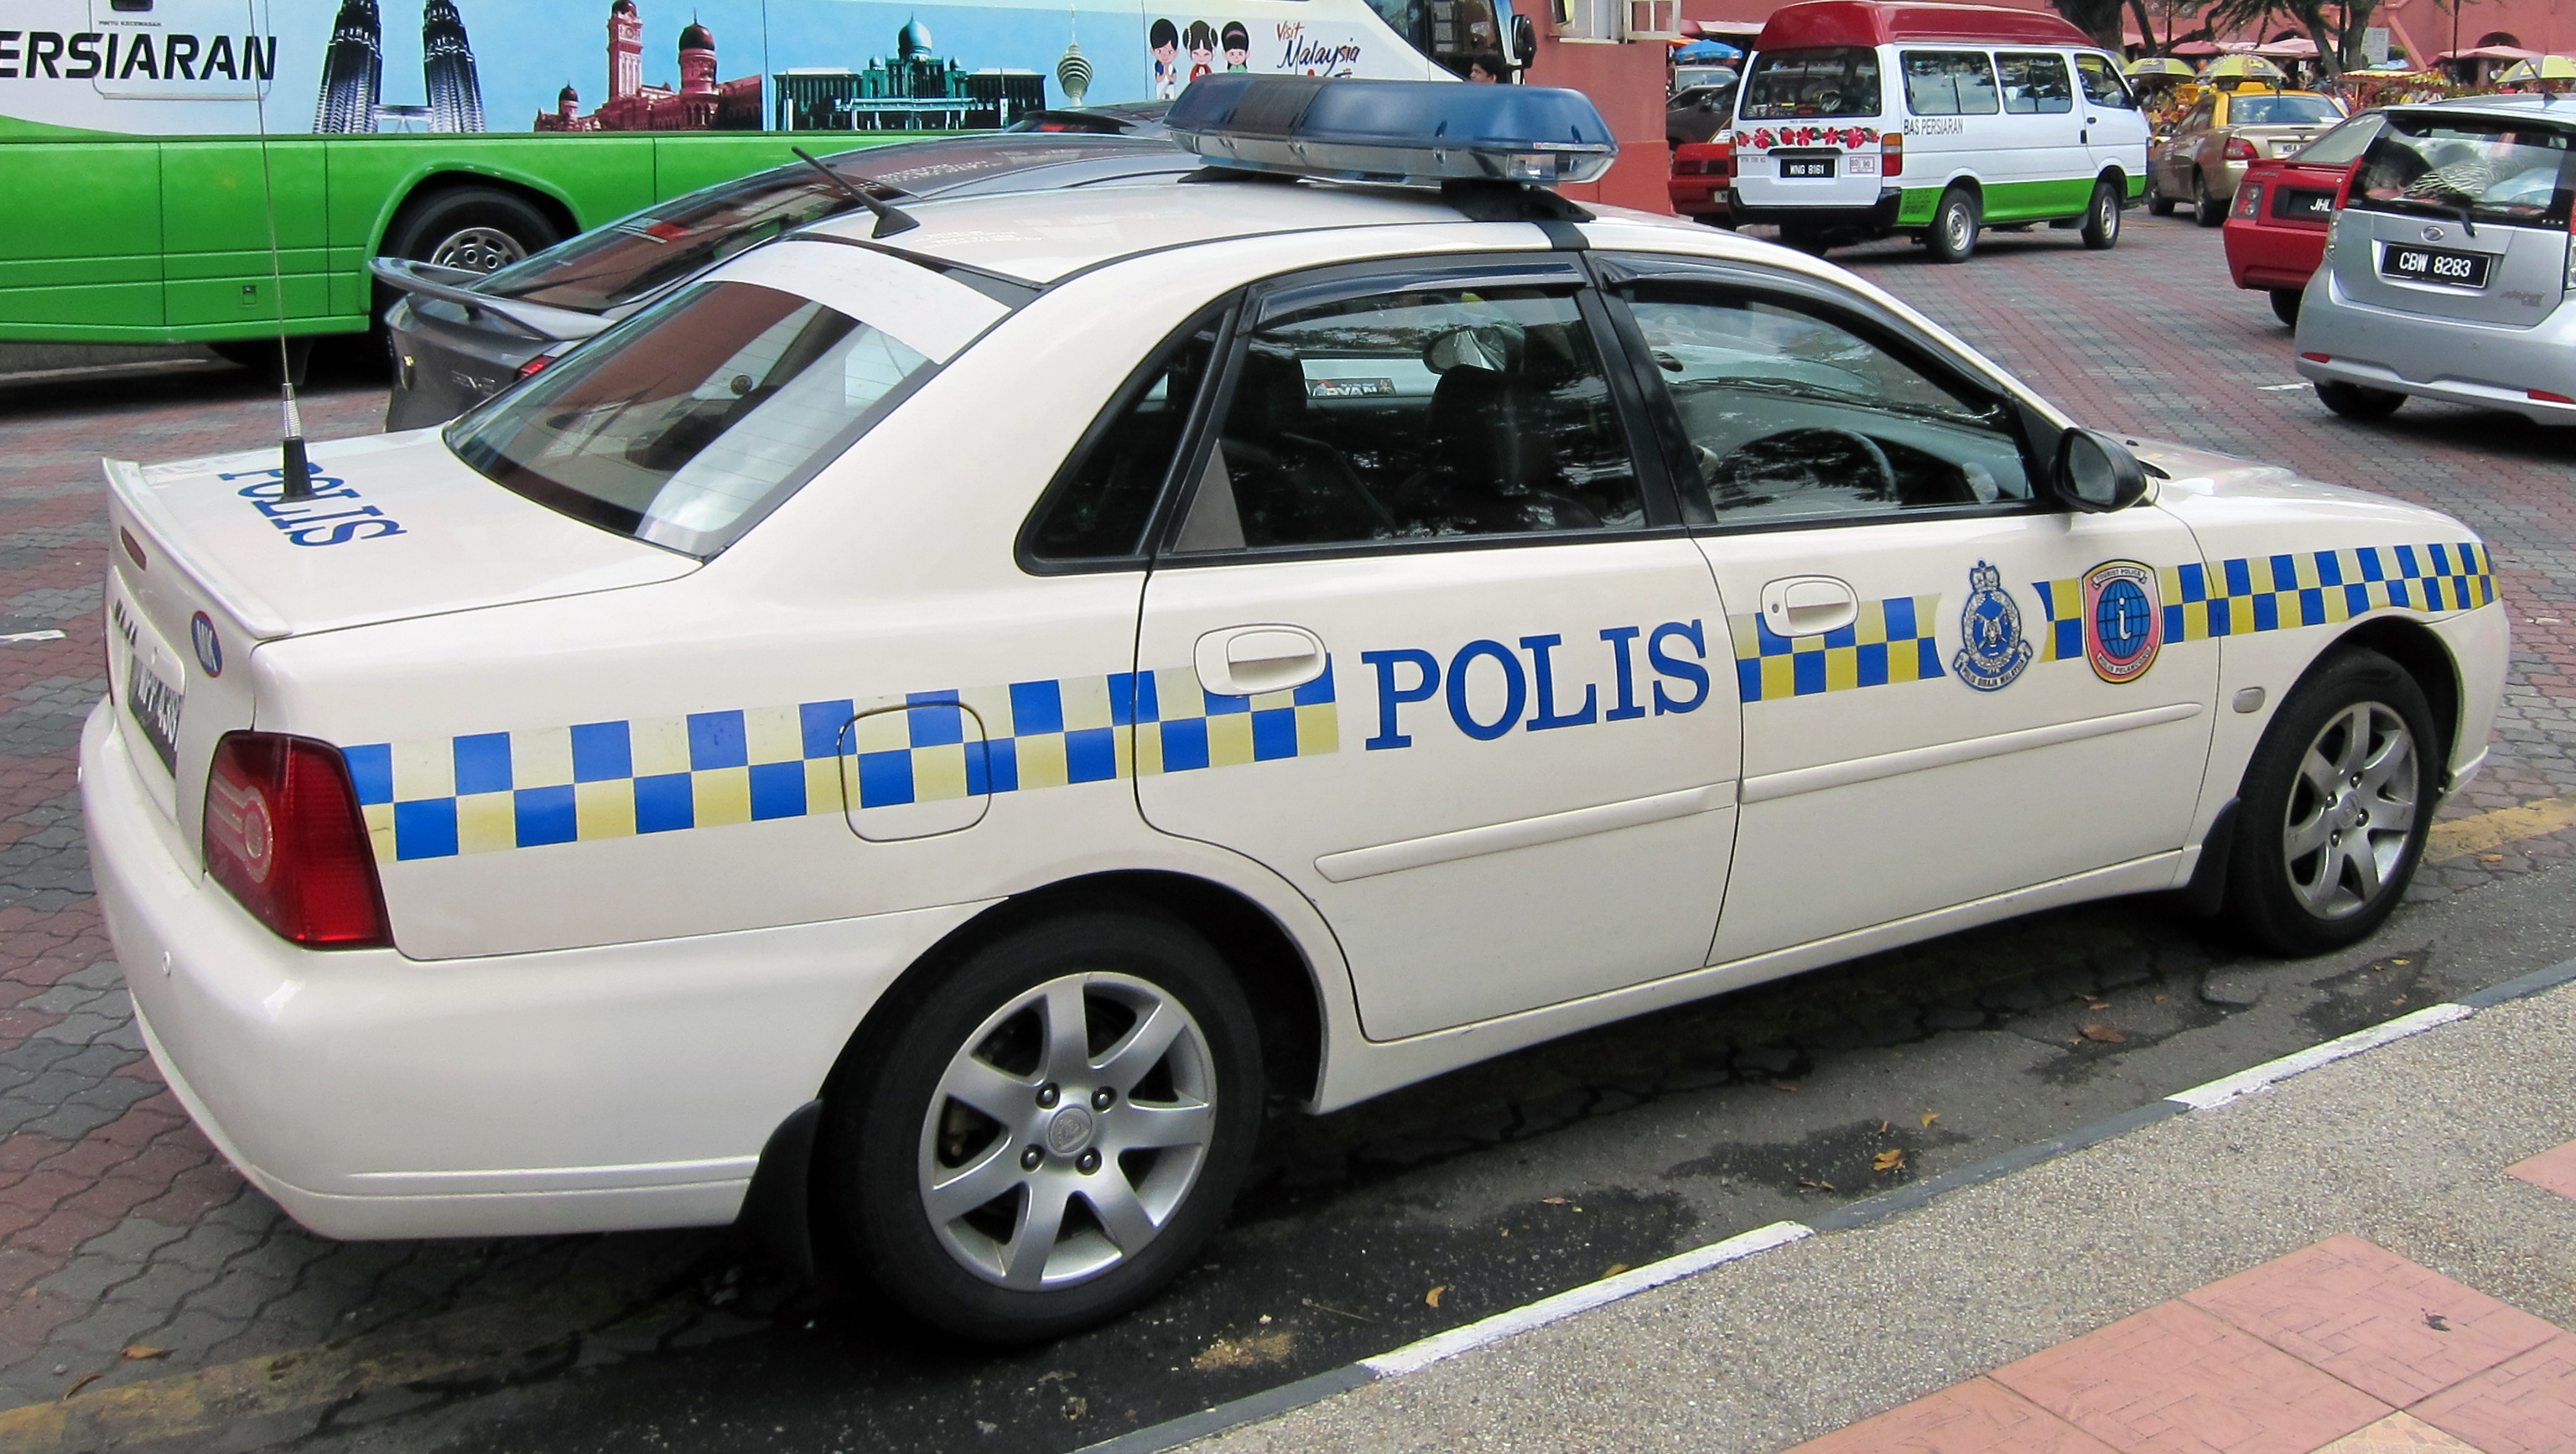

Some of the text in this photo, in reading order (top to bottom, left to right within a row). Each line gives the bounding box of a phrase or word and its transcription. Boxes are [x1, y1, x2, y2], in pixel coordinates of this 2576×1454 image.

[1276, 20, 1305, 41] Visit
[1276, 34, 1360, 76] Malaysia
[1903, 117, 1963, 135] BAS PERSIARAN
[1789, 164, 1825, 175] WNG 8161
[2309, 198, 2331, 211] JHL
[2399, 252, 2472, 278] CBW 8283
[218, 462, 408, 547] POLIS
[1361, 619, 1710, 750] POLIS
